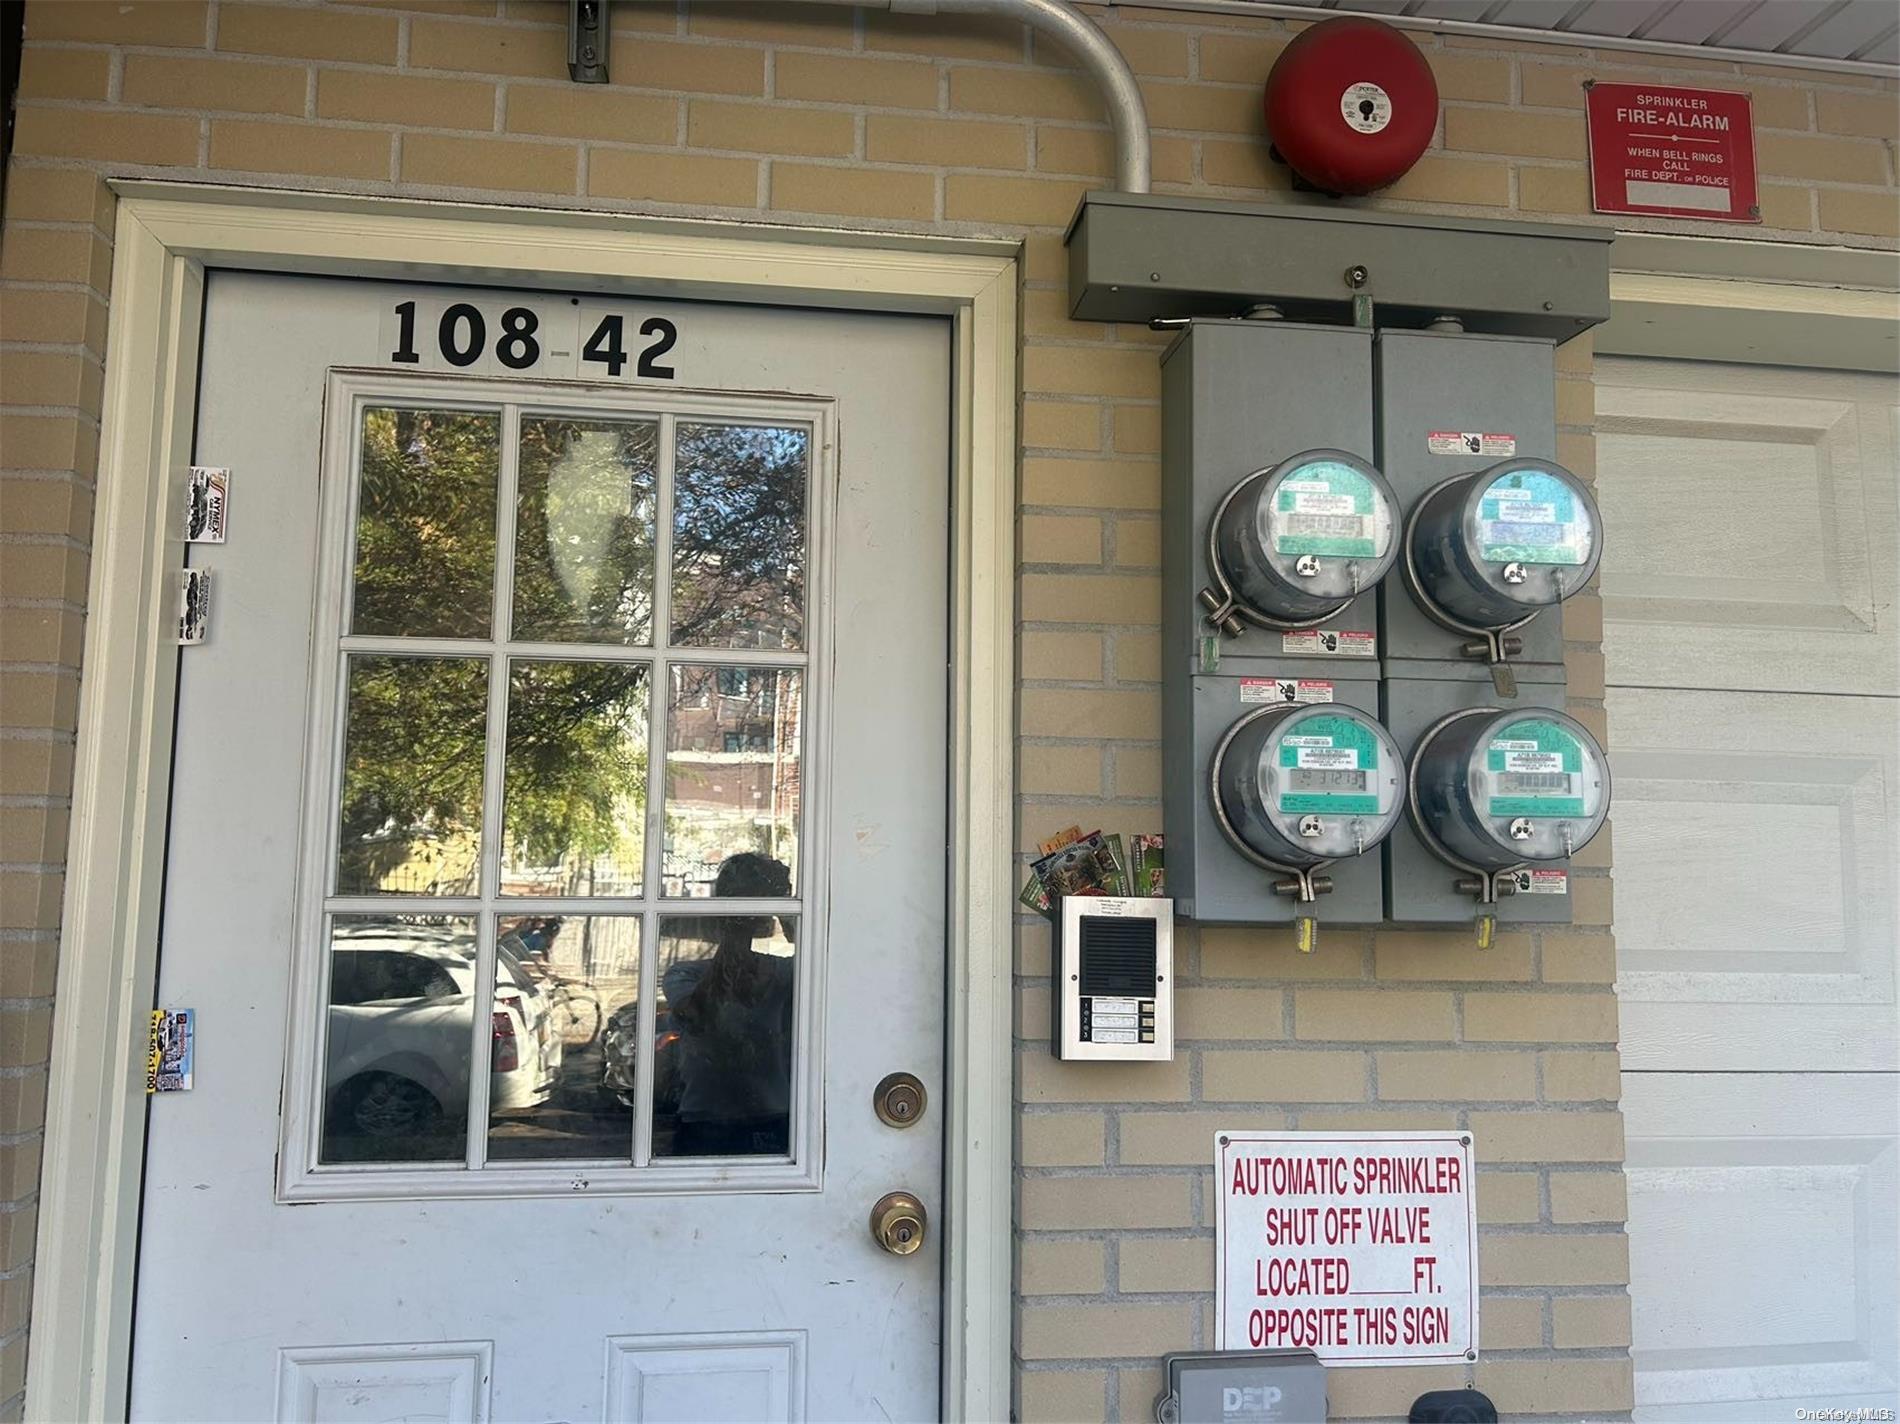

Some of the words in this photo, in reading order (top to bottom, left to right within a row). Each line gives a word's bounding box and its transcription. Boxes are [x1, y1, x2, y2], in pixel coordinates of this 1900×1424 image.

[1636, 94, 1708, 110] SPRINKLER
[1616, 108, 1730, 131] FIRE-ALARM
[1627, 147, 1660, 158] WHEN
[1662, 149, 1690, 160] BELL
[1691, 152, 1724, 164] RINGS
[1662, 160, 1691, 171] CALL
[1624, 168, 1649, 179] FIRE
[1652, 171, 1682, 182] DEPT.
[1695, 175, 1730, 186] POLICE
[211, 496, 221, 535] NYMEX
[1232, 1157, 1348, 1196] AUTOMATIC
[1353, 1157, 1461, 1195] SPRINKLER
[1266, 1207, 1319, 1246] SHUT
[1324, 1207, 1362, 1245] OFF
[1367, 1207, 1431, 1245] VALVE
[1256, 1257, 1350, 1296] LOCATED
[1414, 1256, 1442, 1294] FT.
[1249, 1308, 1348, 1347] OPPOSITE
[1353, 1307, 1397, 1346] THIS
[1403, 1306, 1449, 1345] SIGN
[1223, 1386, 1282, 1412] DEP
